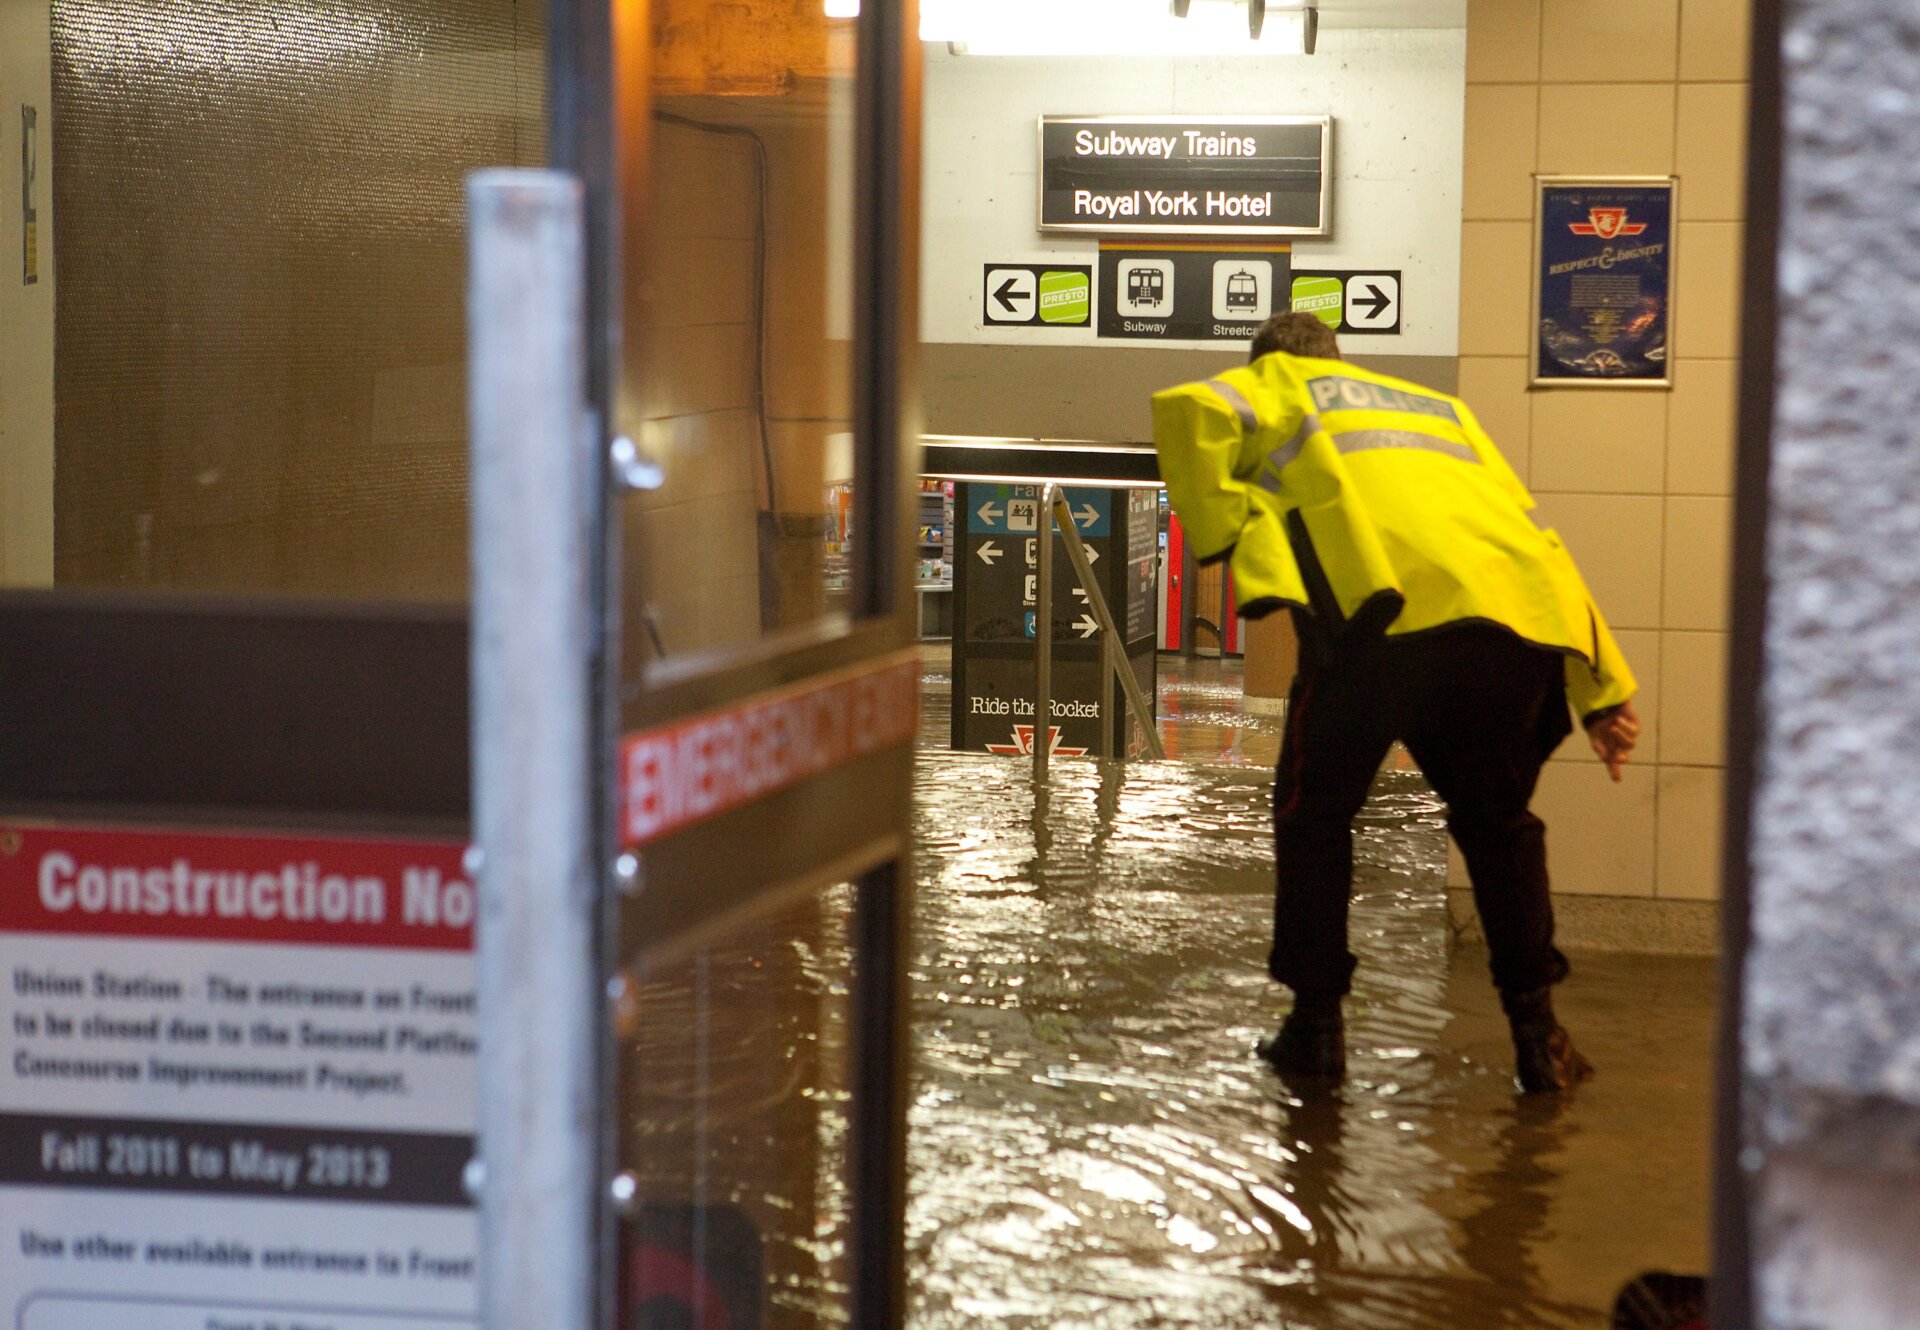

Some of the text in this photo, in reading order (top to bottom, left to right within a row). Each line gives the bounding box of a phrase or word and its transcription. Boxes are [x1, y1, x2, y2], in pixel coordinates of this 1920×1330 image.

[1075, 130, 1257, 159] Subway Trains
[1074, 190, 1271, 219] Royal York Hotel
[1549, 257, 1598, 275] RESPECT
[1616, 243, 1663, 261] DIGNITY
[1043, 290, 1085, 306] PRESTO
[1296, 295, 1339, 310] PRESTO
[1123, 320, 1167, 336] Subway
[1212, 323, 1259, 336] Streetca
[971, 696, 1009, 715] Ride
[1049, 699, 1099, 719] Rocket
[38, 851, 474, 928] Construction No
[13, 968, 83, 997] Union
[93, 968, 182, 999] Station
[207, 973, 248, 1003] The
[258, 984, 364, 1010] entrance
[14, 1012, 37, 1036] to
[46, 1012, 73, 1037] be
[81, 1015, 159, 1041] closed
[167, 1018, 209, 1043] due
[217, 1022, 242, 1044] to
[251, 1022, 287, 1047] the
[301, 1022, 387, 1051] Second
[13, 1048, 140, 1081] Concourse
[149, 1056, 307, 1089] Improvement
[42, 1130, 390, 1191] Fall 2011 to May 2013
[20, 1229, 65, 1258] Use
[72, 1234, 135, 1262] other
[145, 1241, 252, 1268] available
[261, 1248, 366, 1275] entrance
[375, 1250, 402, 1275] to
